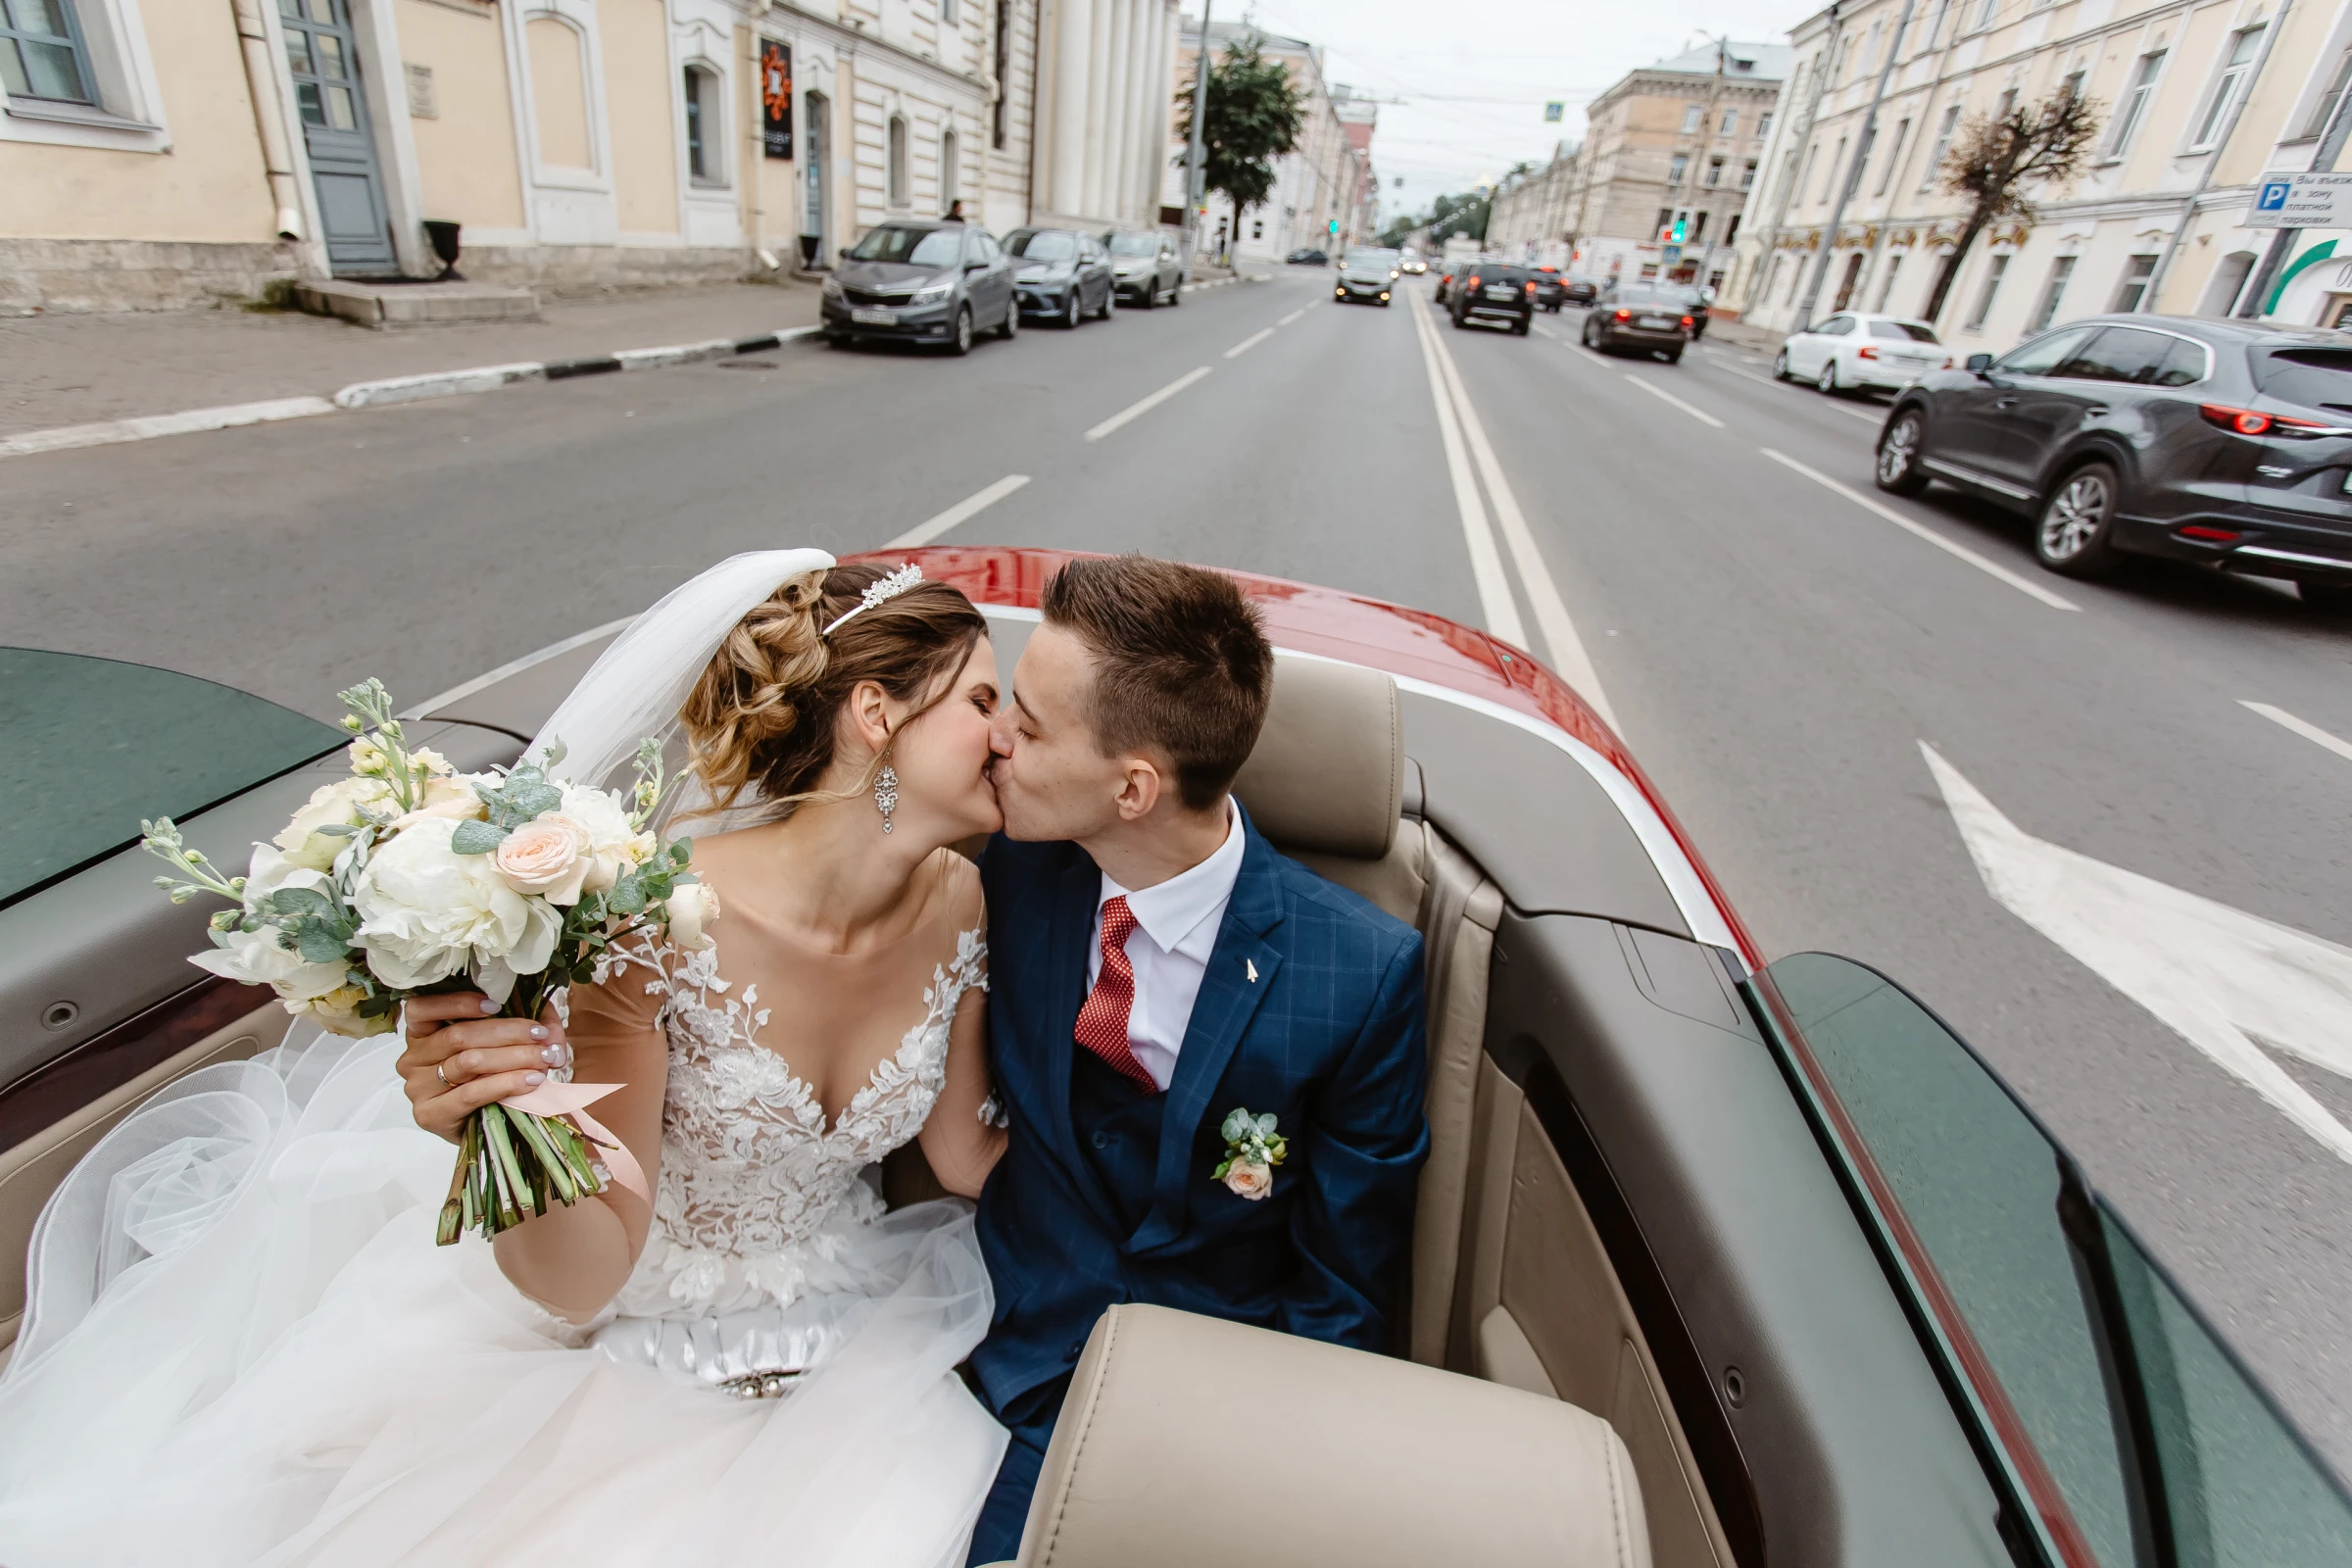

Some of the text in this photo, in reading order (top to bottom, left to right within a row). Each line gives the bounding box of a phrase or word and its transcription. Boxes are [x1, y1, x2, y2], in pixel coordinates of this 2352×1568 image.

[2296, 175, 2315, 185] Вы
[2263, 186, 2286, 208] P
[2306, 190, 2333, 200] зону
[2285, 202, 2333, 211] платной
[2280, 217, 2332, 226] парковки
